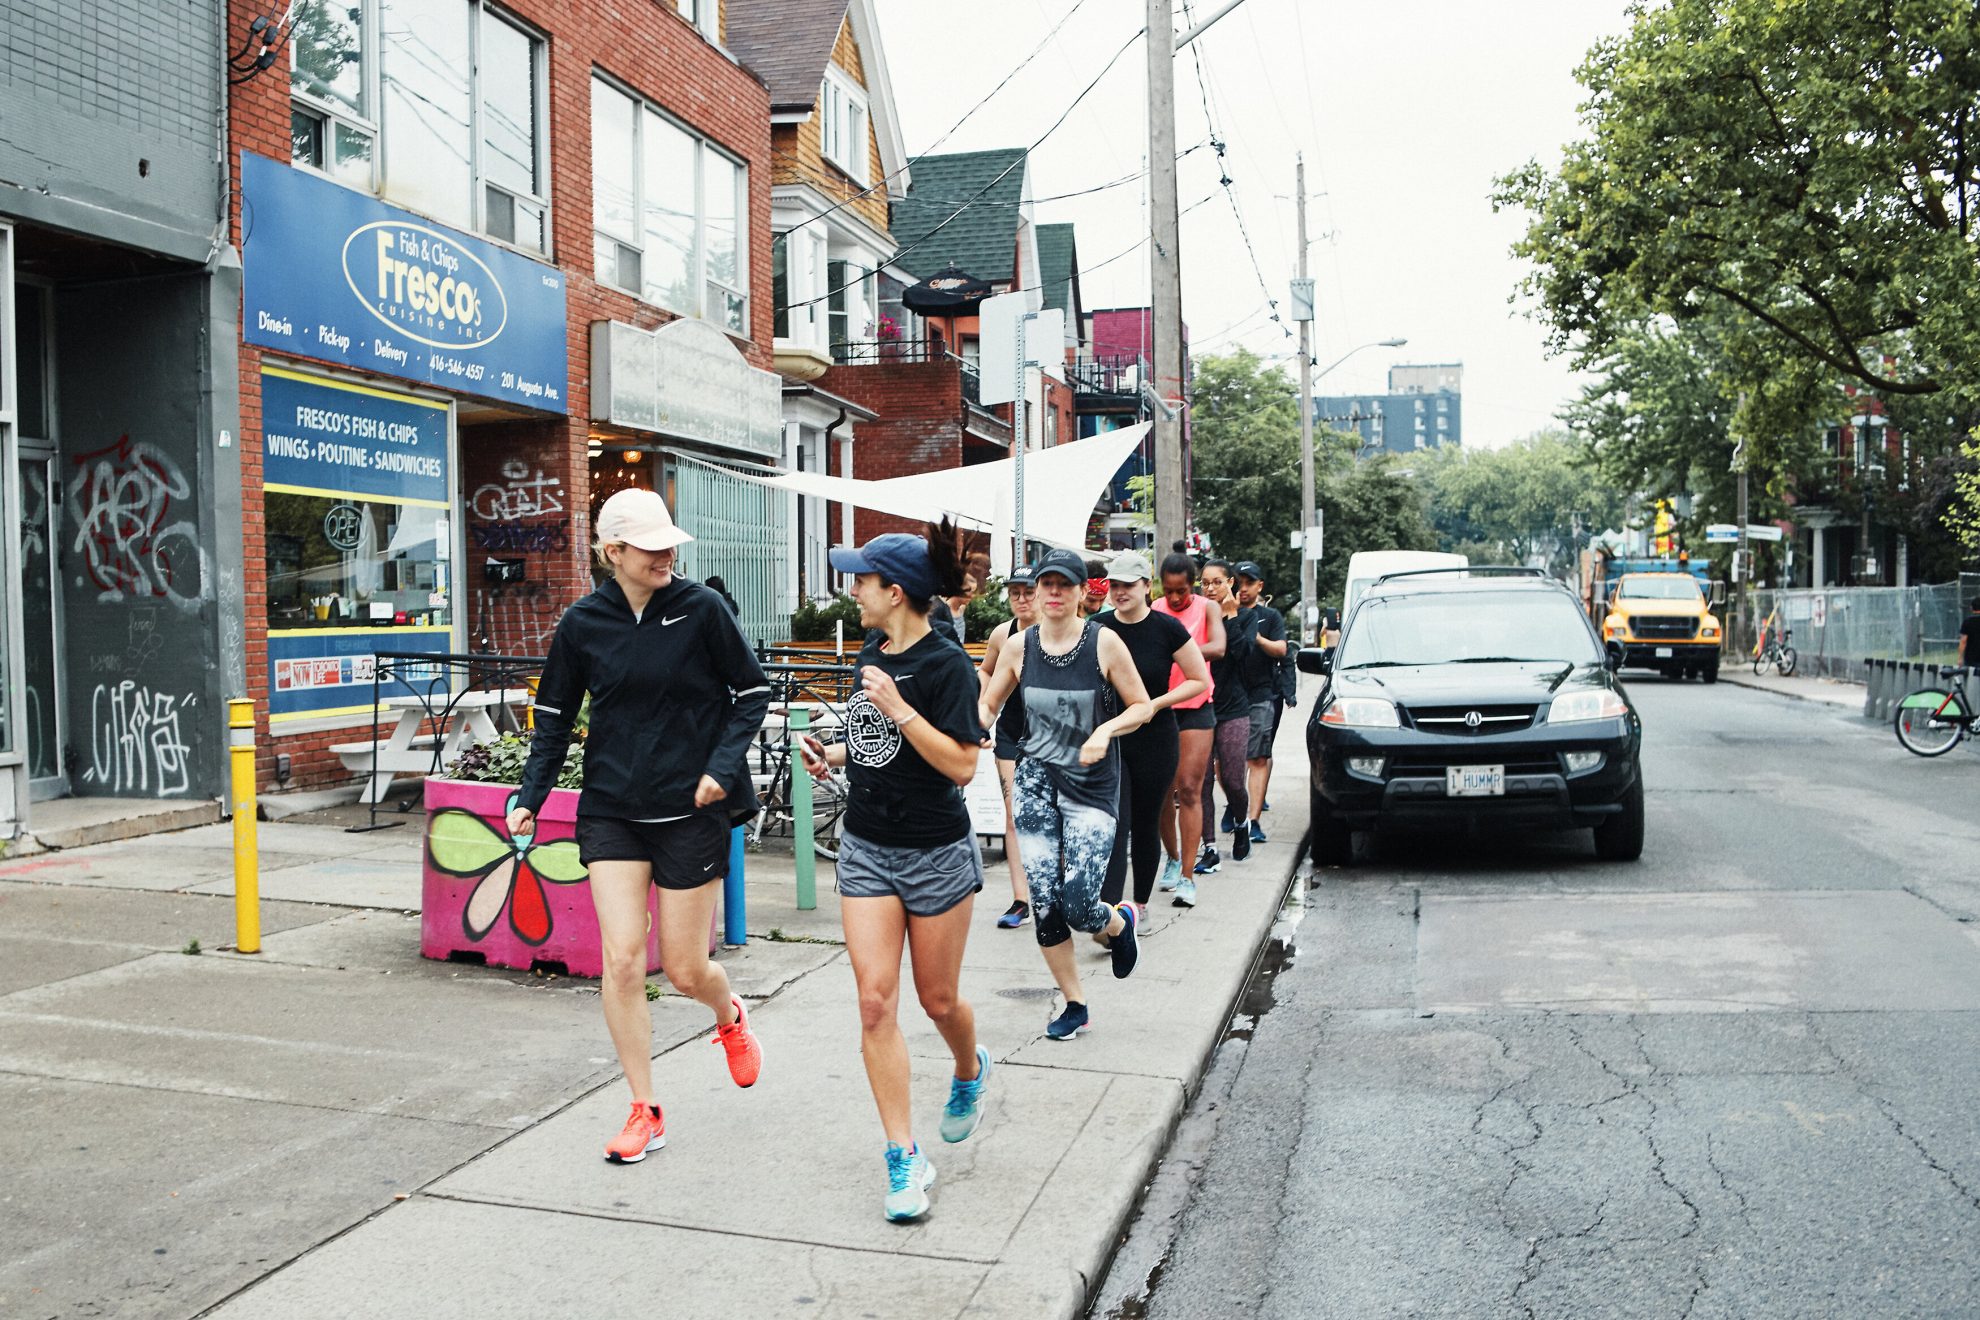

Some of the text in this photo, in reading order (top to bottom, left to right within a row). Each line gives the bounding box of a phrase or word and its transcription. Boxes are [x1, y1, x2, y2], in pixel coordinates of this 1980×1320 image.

[399, 231, 459, 275] Fish & Chips
[377, 229, 482, 327] Fresco's
[258, 310, 292, 336] Dine-in
[318, 324, 350, 354] Pick-up
[374, 338, 408, 367] Delivery
[501, 371, 514, 389] 201
[516, 375, 543, 398] Augusta
[296, 405, 418, 446] FRESCO'S FISH & CHIPS
[267, 434, 441, 478] WINGS POUTINE SANDWICHES
[292, 664, 311, 687] NOW
[313, 672, 326, 684] LIFE
[1463, 773, 1502, 789] HUMMR
